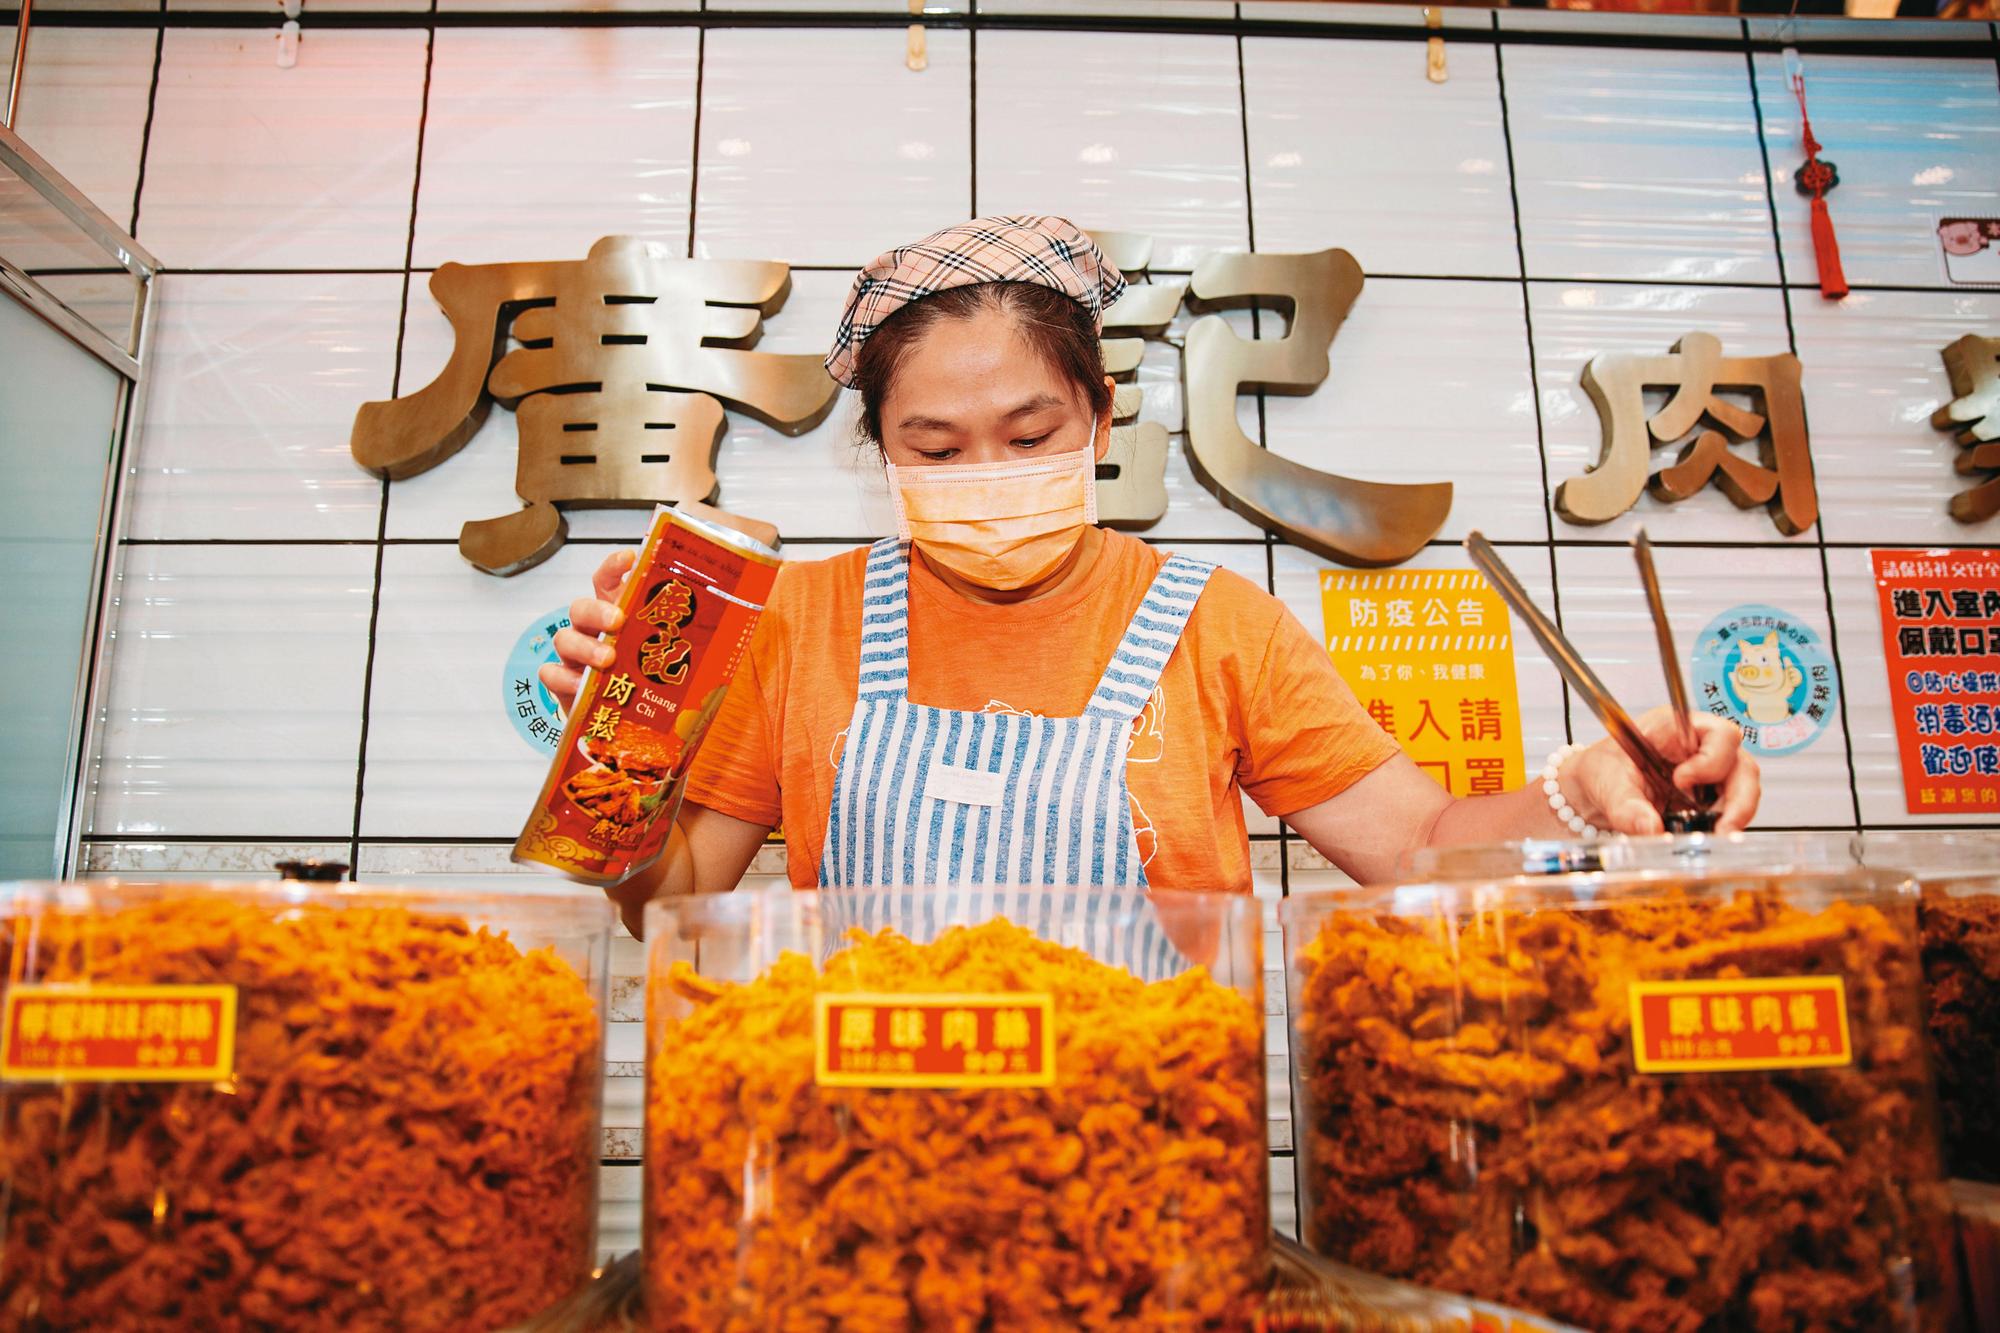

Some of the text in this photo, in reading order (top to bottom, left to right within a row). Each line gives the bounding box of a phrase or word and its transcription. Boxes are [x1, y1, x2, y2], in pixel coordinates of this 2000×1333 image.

[1553, 331, 2000, 537] 肉
[1348, 598, 1485, 628] 防疫公告
[635, 701, 657, 719] Chi
[641, 687, 677, 713] Kuang
[1914, 703, 2000, 736] 消毒酒
[1920, 744, 2000, 776] 歡迎使
